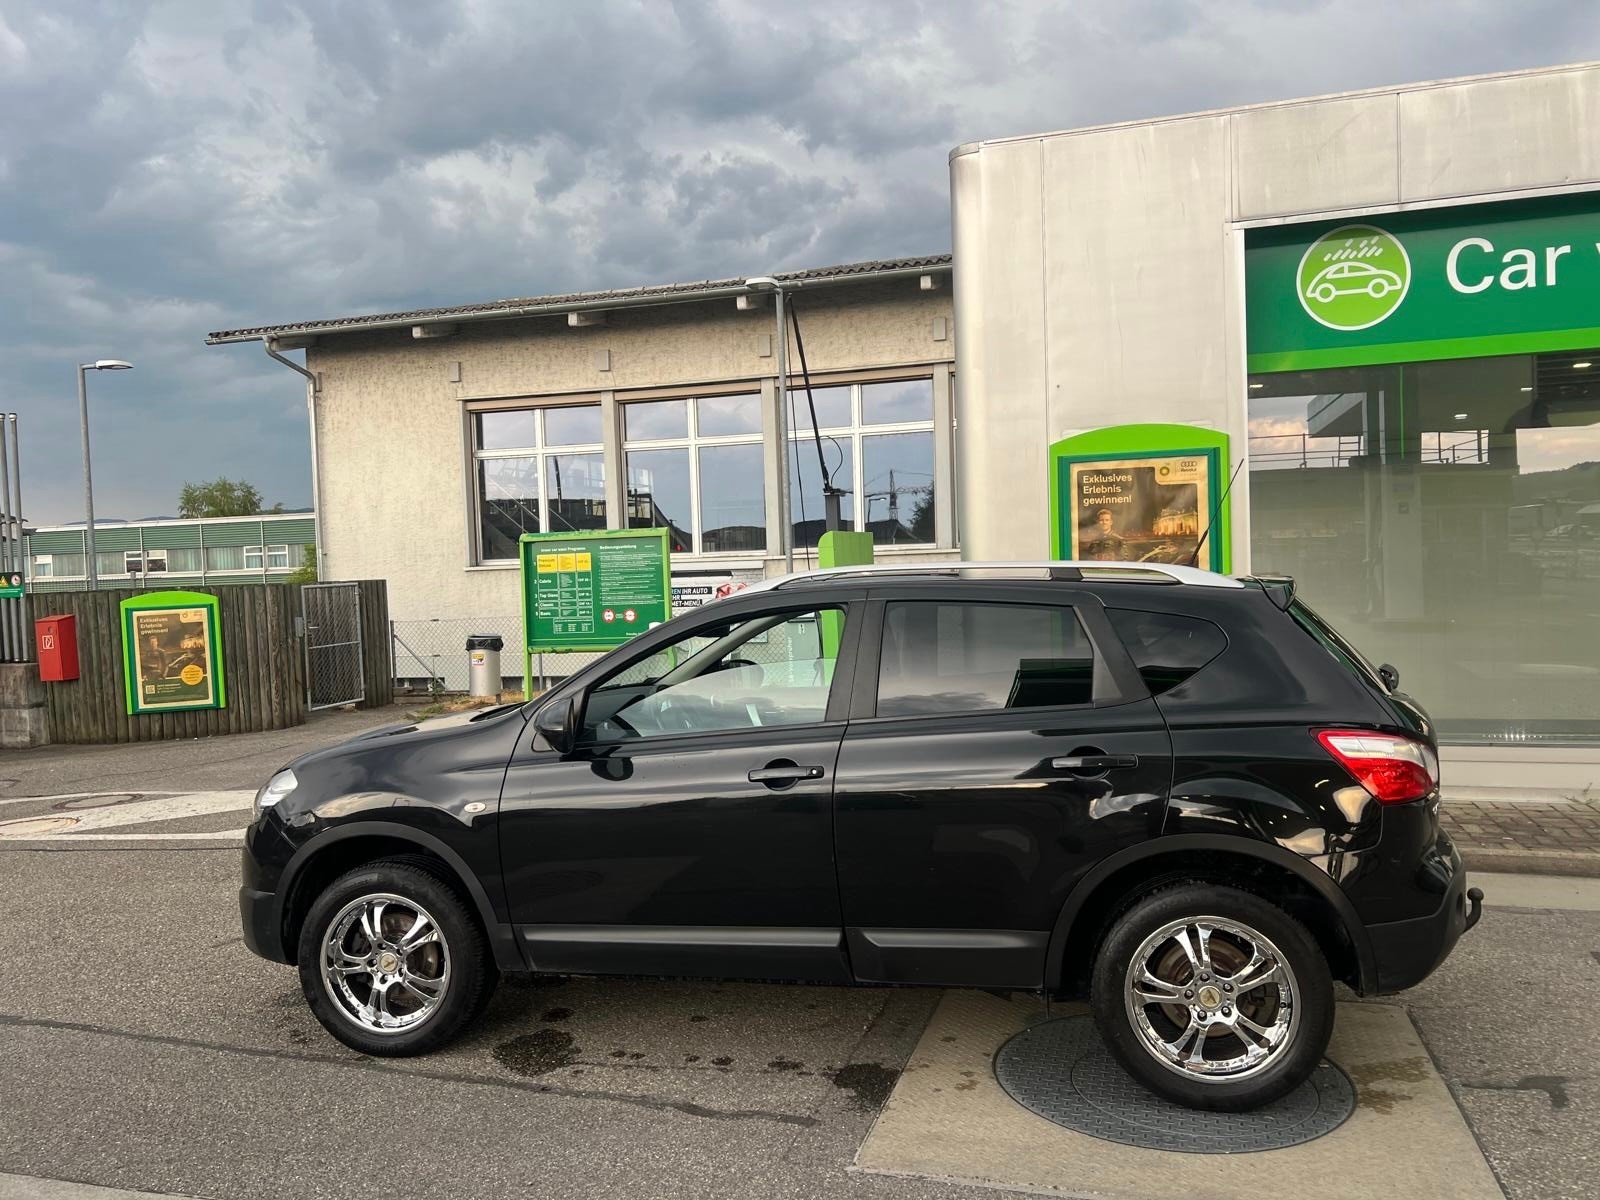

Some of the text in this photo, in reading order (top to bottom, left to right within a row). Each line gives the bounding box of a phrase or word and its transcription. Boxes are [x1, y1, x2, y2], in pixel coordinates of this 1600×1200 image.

[1446, 237, 1571, 294] Car
[1083, 474, 1132, 483] Exklusives
[1084, 485, 1122, 494] Erlebnis
[1083, 496, 1132, 506] gewinnen!
